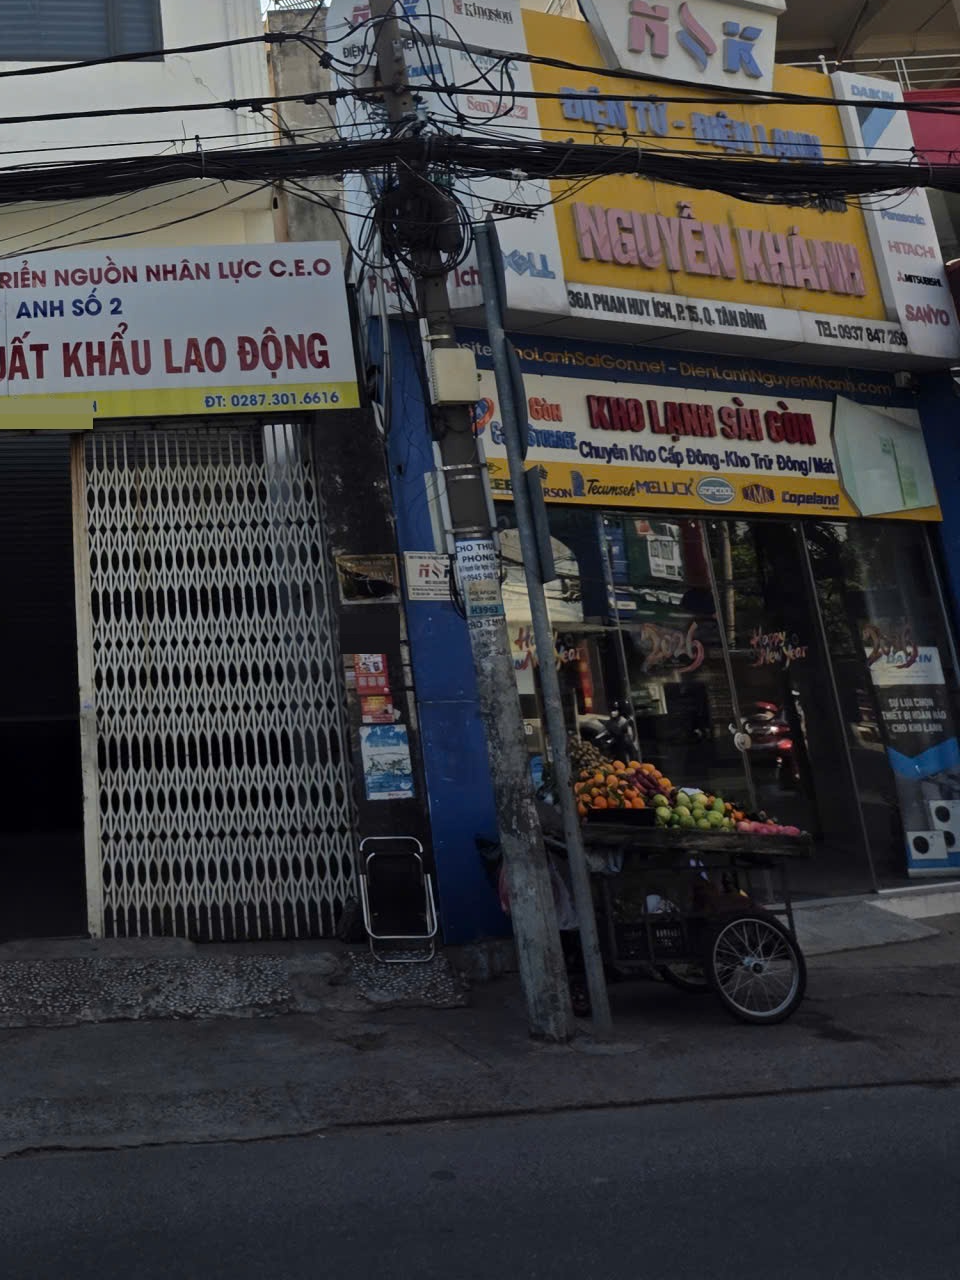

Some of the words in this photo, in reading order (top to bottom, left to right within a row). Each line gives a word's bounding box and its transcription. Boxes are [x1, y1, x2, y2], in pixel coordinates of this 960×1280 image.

[464, 2, 513, 22] Kingston
[851, 85, 896, 101] DAIKIN
[559, 86, 629, 132] ĐIỆN
[492, 203, 542, 220] BOSE
[880, 209, 926, 225] Panasonic
[735, 225, 866, 299] KHÁNH
[887, 240, 936, 259] HITACHI
[54, 255, 138, 286] NGUỒN
[145, 258, 211, 282] NHÂN
[218, 258, 262, 283] LỰC
[269, 258, 331, 277] C.E.O
[72, 287, 103, 317] SỐ
[109, 297, 123, 315] 2
[568, 290, 592, 310] 36A
[593, 293, 627, 315] PHAN
[627, 297, 651, 317] HUY
[715, 306, 739, 327] TÂN
[739, 308, 767, 330] BÌNH
[905, 303, 950, 326] SANYO
[815, 320, 838, 338] TEL:
[840, 324, 863, 341] 0937
[866, 328, 886, 343] 847
[62, 322, 152, 377] KHẨU
[164, 336, 227, 374] LAO
[237, 326, 330, 379] ĐỘNG
[517, 347, 665, 374] hoLanhSaiGon.net
[204, 395, 226, 409] ĐT:
[231, 391, 340, 408] 0287.301.6616
[587, 395, 645, 432] KHO
[647, 400, 717, 442] LẠNH
[719, 397, 764, 442] SÀI
[766, 401, 816, 445] GÒN
[579, 441, 628, 464] Chuyên
[630, 444, 656, 462] Kho
[658, 446, 684, 468] Cấp
[587, 479, 636, 497] Tecumseh
[781, 491, 839, 507] Copeland
[641, 621, 705, 673] 2026
[750, 625, 786, 648] Happy
[783, 646, 808, 670] Year
